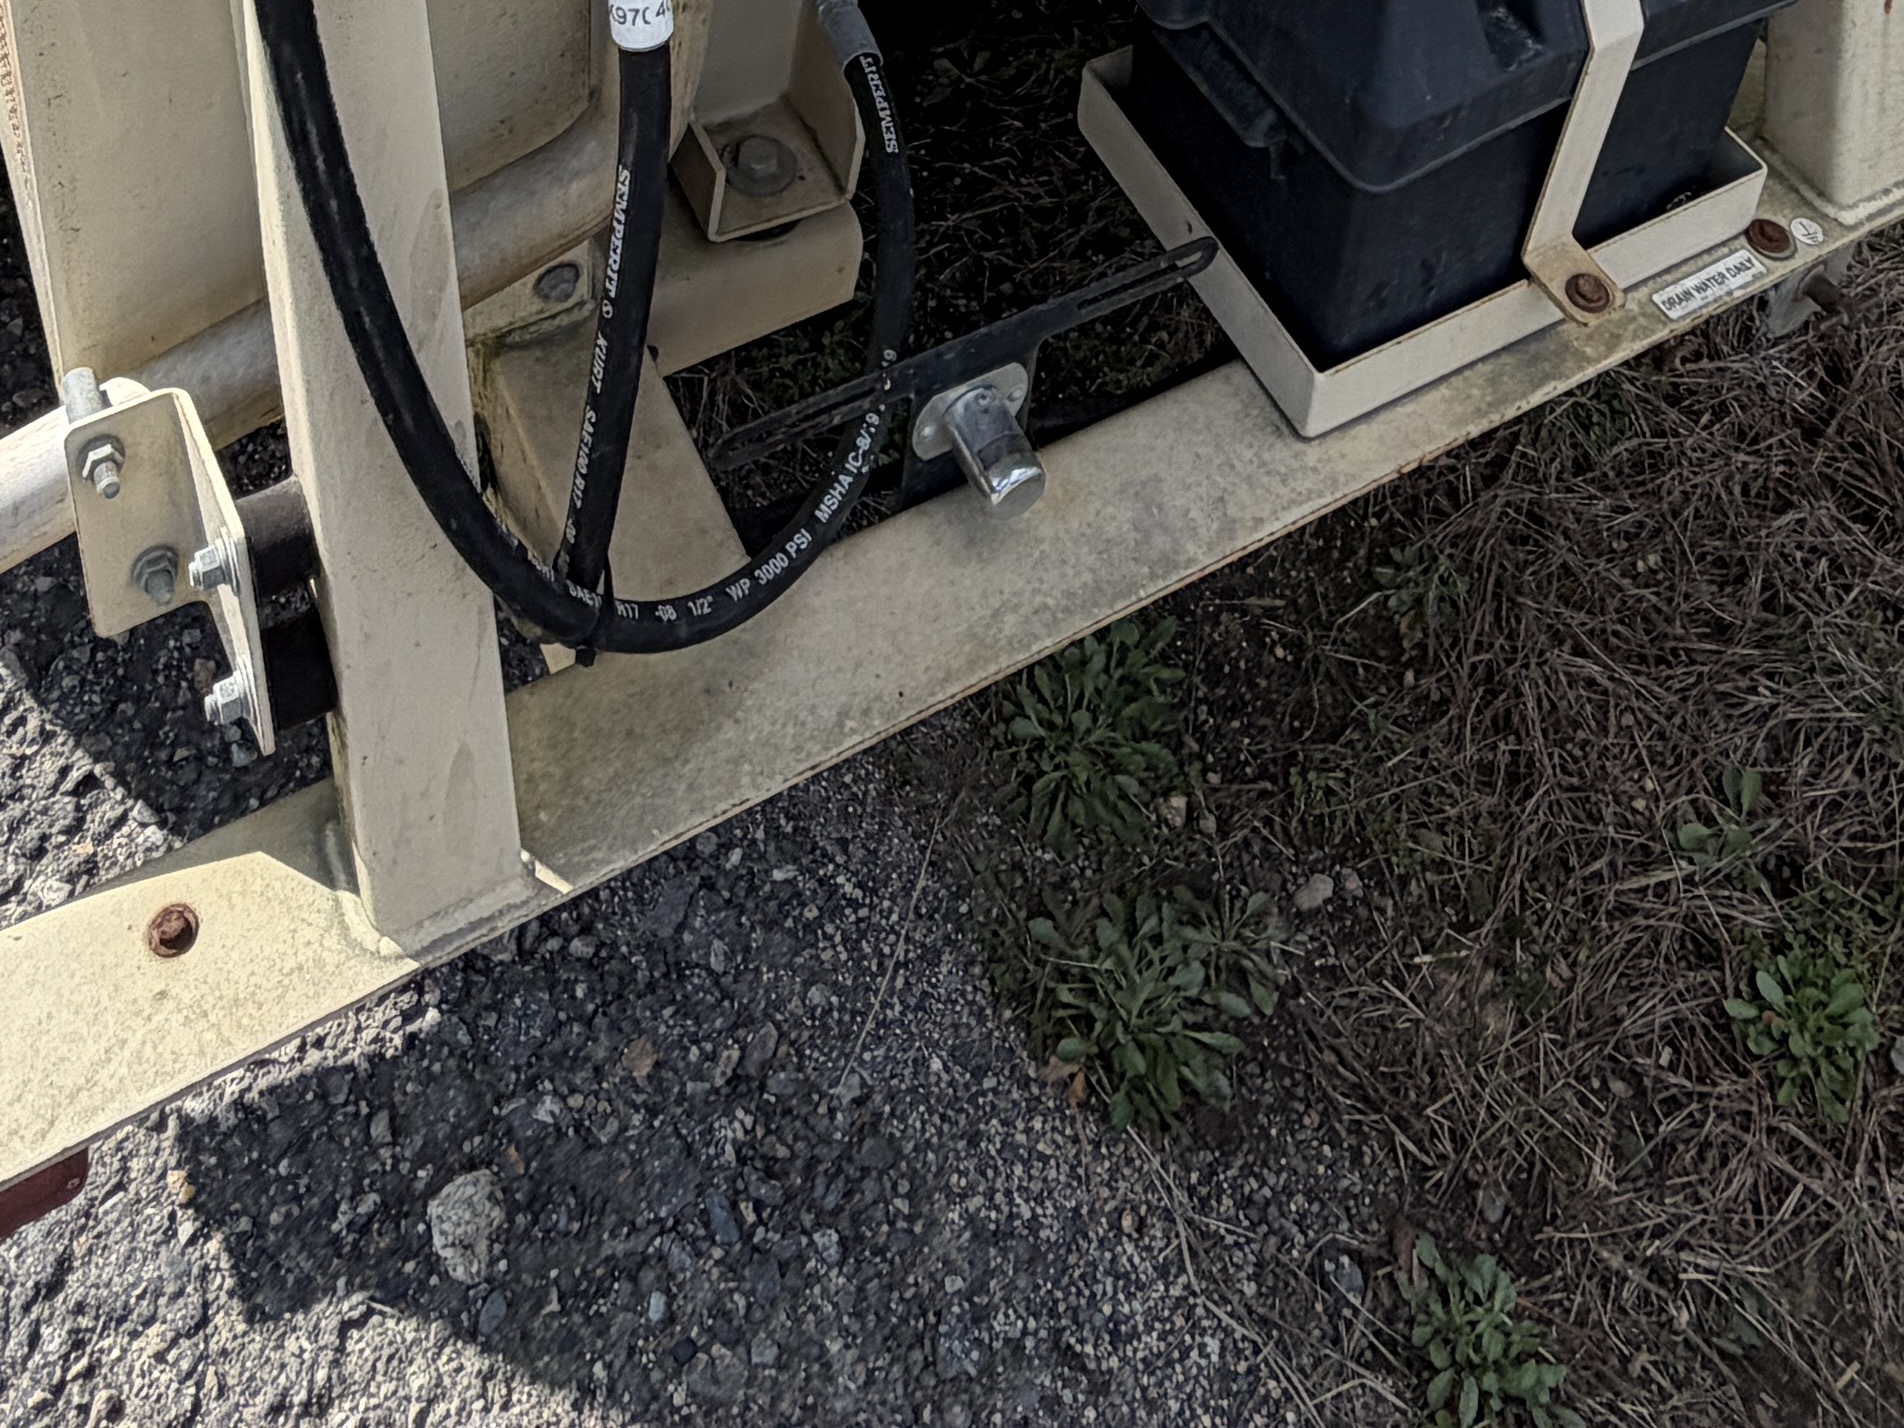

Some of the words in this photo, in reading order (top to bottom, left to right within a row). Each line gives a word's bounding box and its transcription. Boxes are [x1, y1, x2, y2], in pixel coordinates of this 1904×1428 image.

[859, 54, 900, 154] SEMPERIT
[604, 164, 631, 299] SEMPERIT
[1661, 287, 1697, 312] DRAIN
[1692, 271, 1728, 296] WATER
[1729, 256, 1756, 279] DAILY
[591, 330, 609, 395] KURT
[725, 577, 752, 604] WP
[753, 552, 790, 586] 3000
[785, 528, 813, 559] PSI
[814, 474, 854, 524] MSHA
